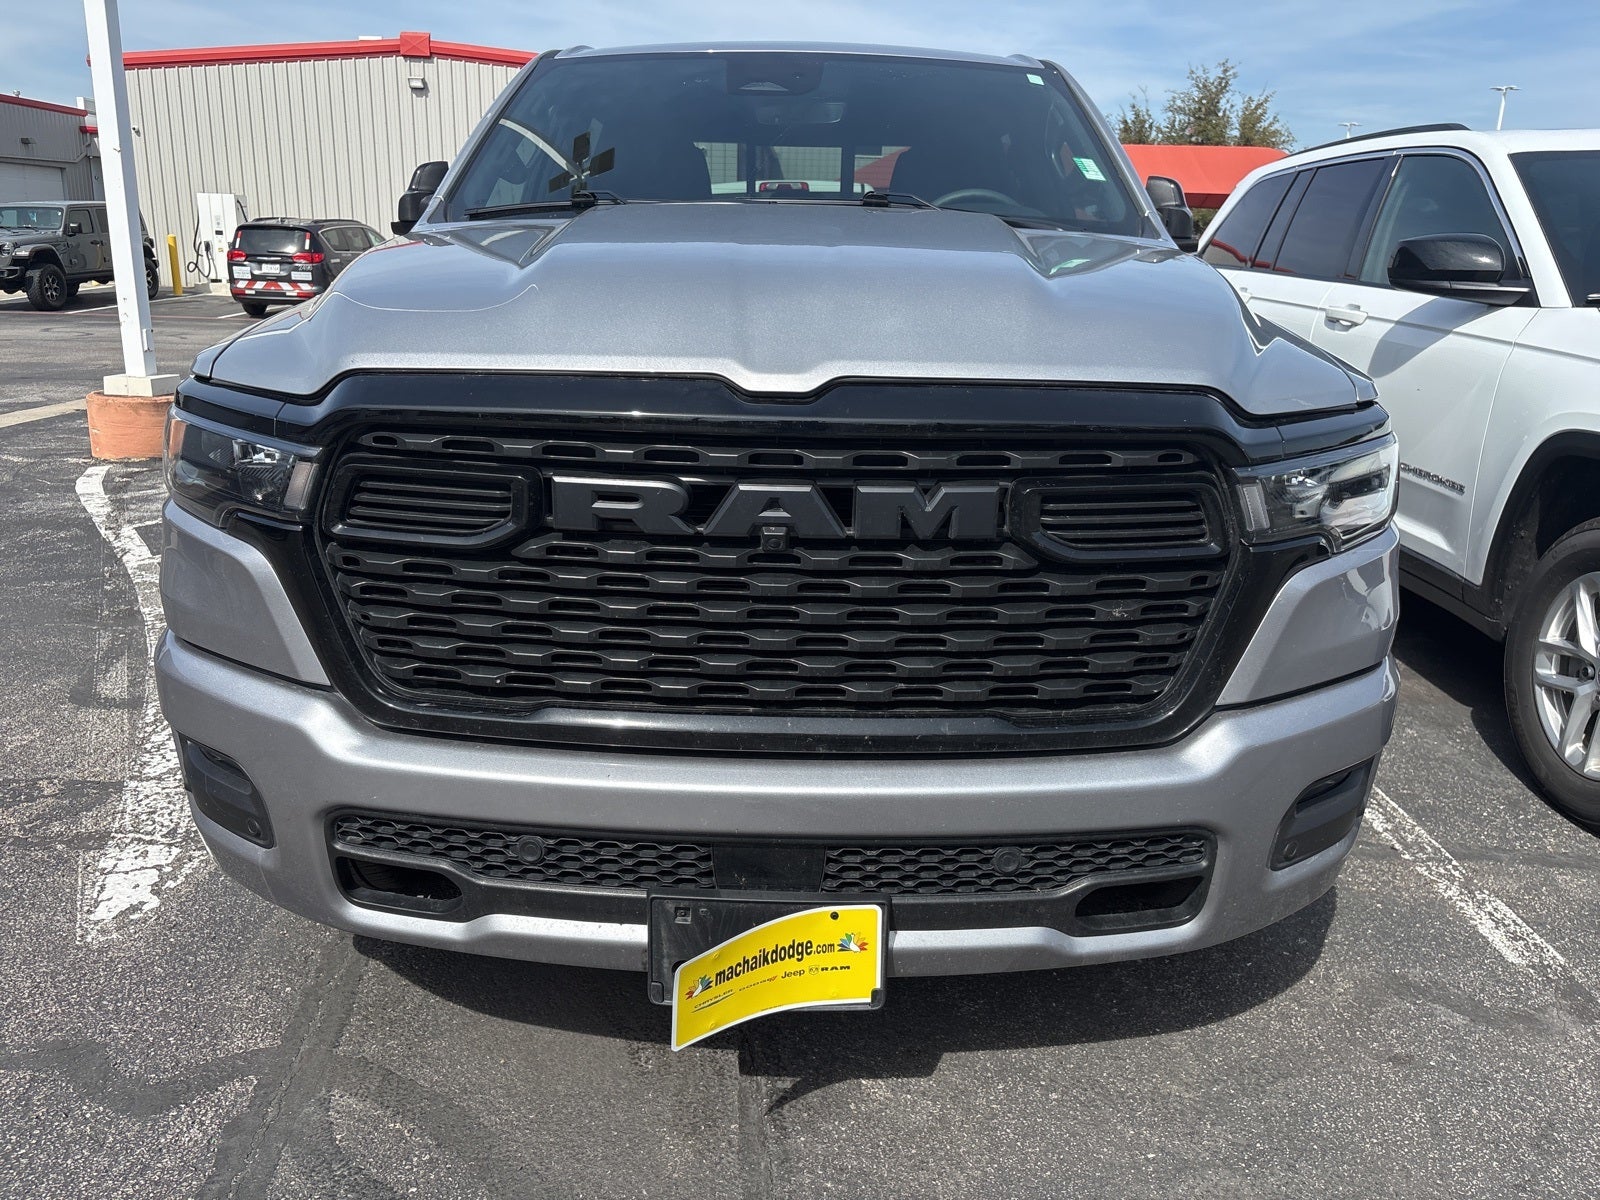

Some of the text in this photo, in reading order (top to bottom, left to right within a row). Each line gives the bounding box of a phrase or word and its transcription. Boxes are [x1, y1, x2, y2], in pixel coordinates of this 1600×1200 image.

[551, 475, 1001, 540] RAM
[714, 938, 835, 987] machaikdodge.com
[781, 969, 806, 979] Jeep
